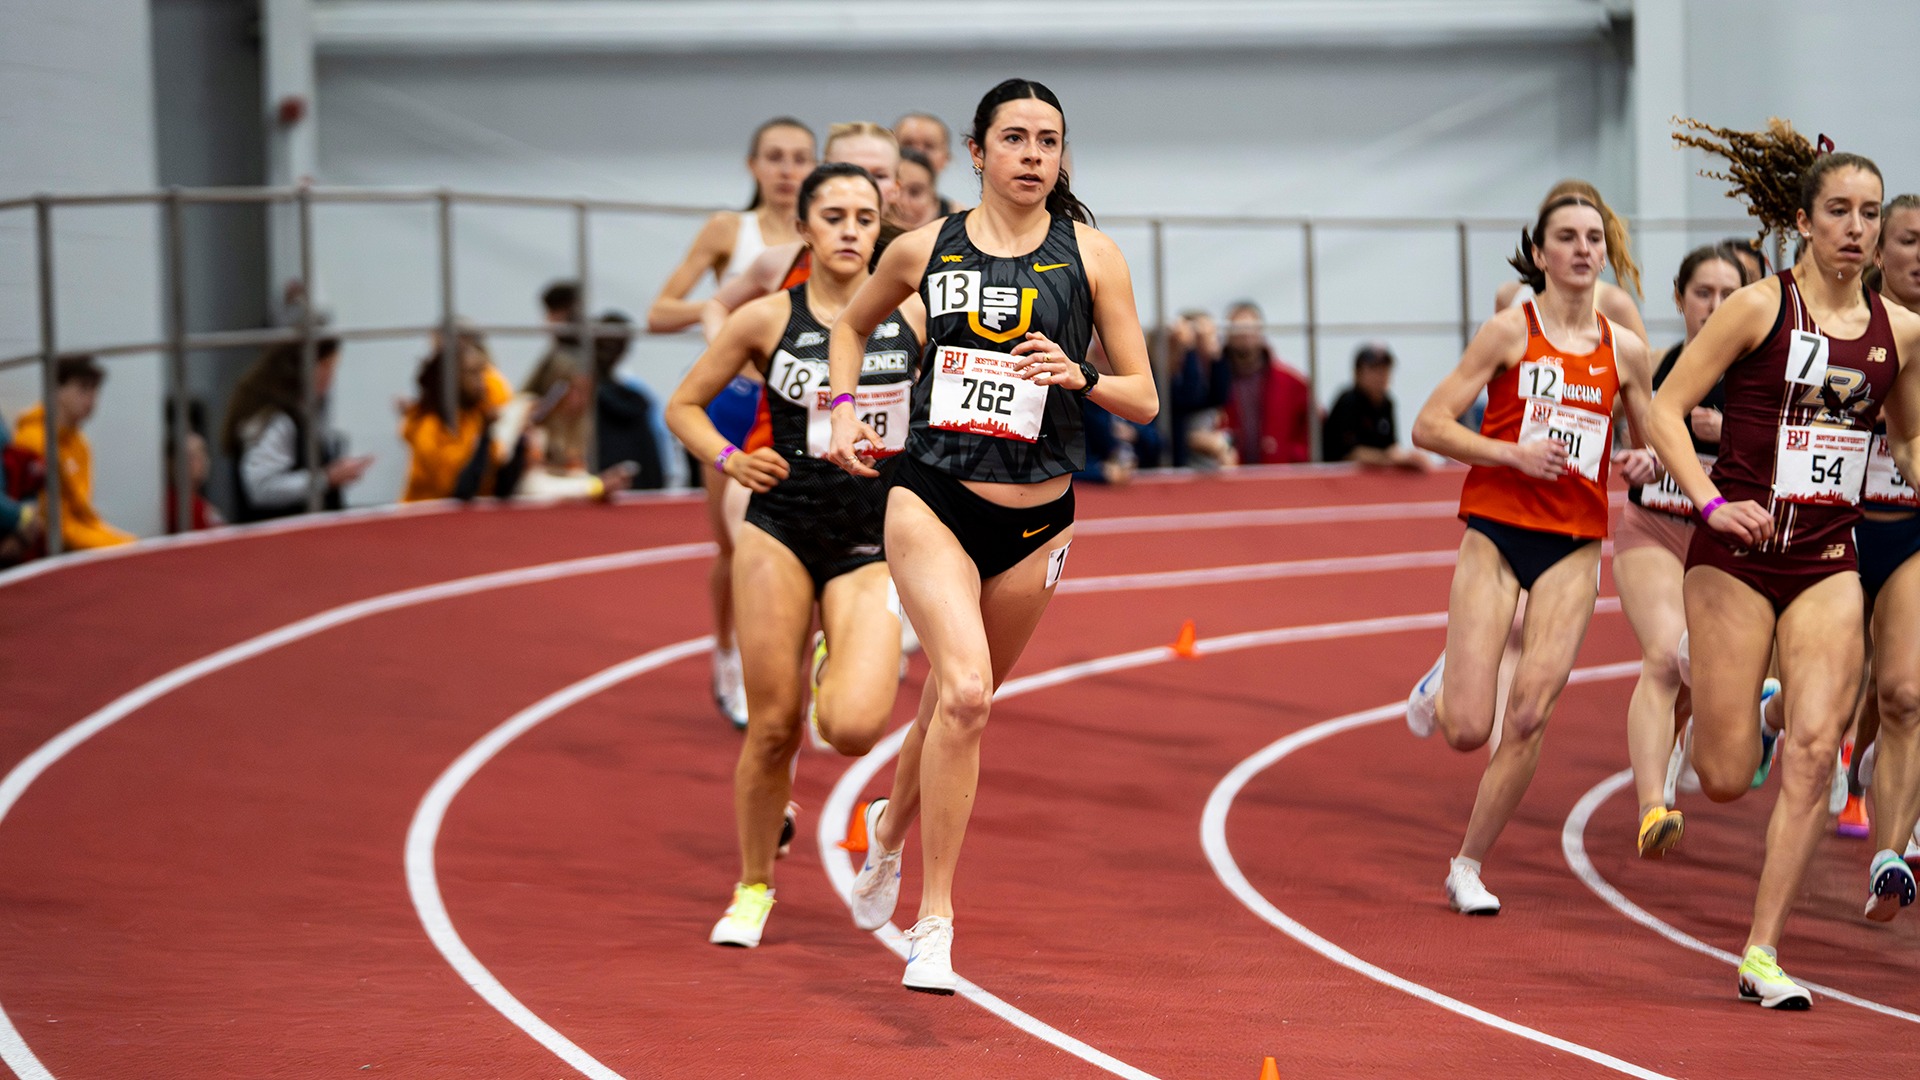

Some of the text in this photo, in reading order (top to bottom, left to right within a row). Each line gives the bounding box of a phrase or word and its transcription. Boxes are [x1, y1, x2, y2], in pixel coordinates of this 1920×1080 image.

[936, 273, 970, 311] 13
[943, 350, 968, 371] BU
[974, 356, 998, 366] BOSTON
[1798, 335, 1821, 379] 7
[780, 361, 811, 400] 18
[961, 377, 1015, 415] 762
[1528, 367, 1557, 399] 12
[1787, 430, 1810, 447] BU
[1812, 454, 1844, 485] 54
